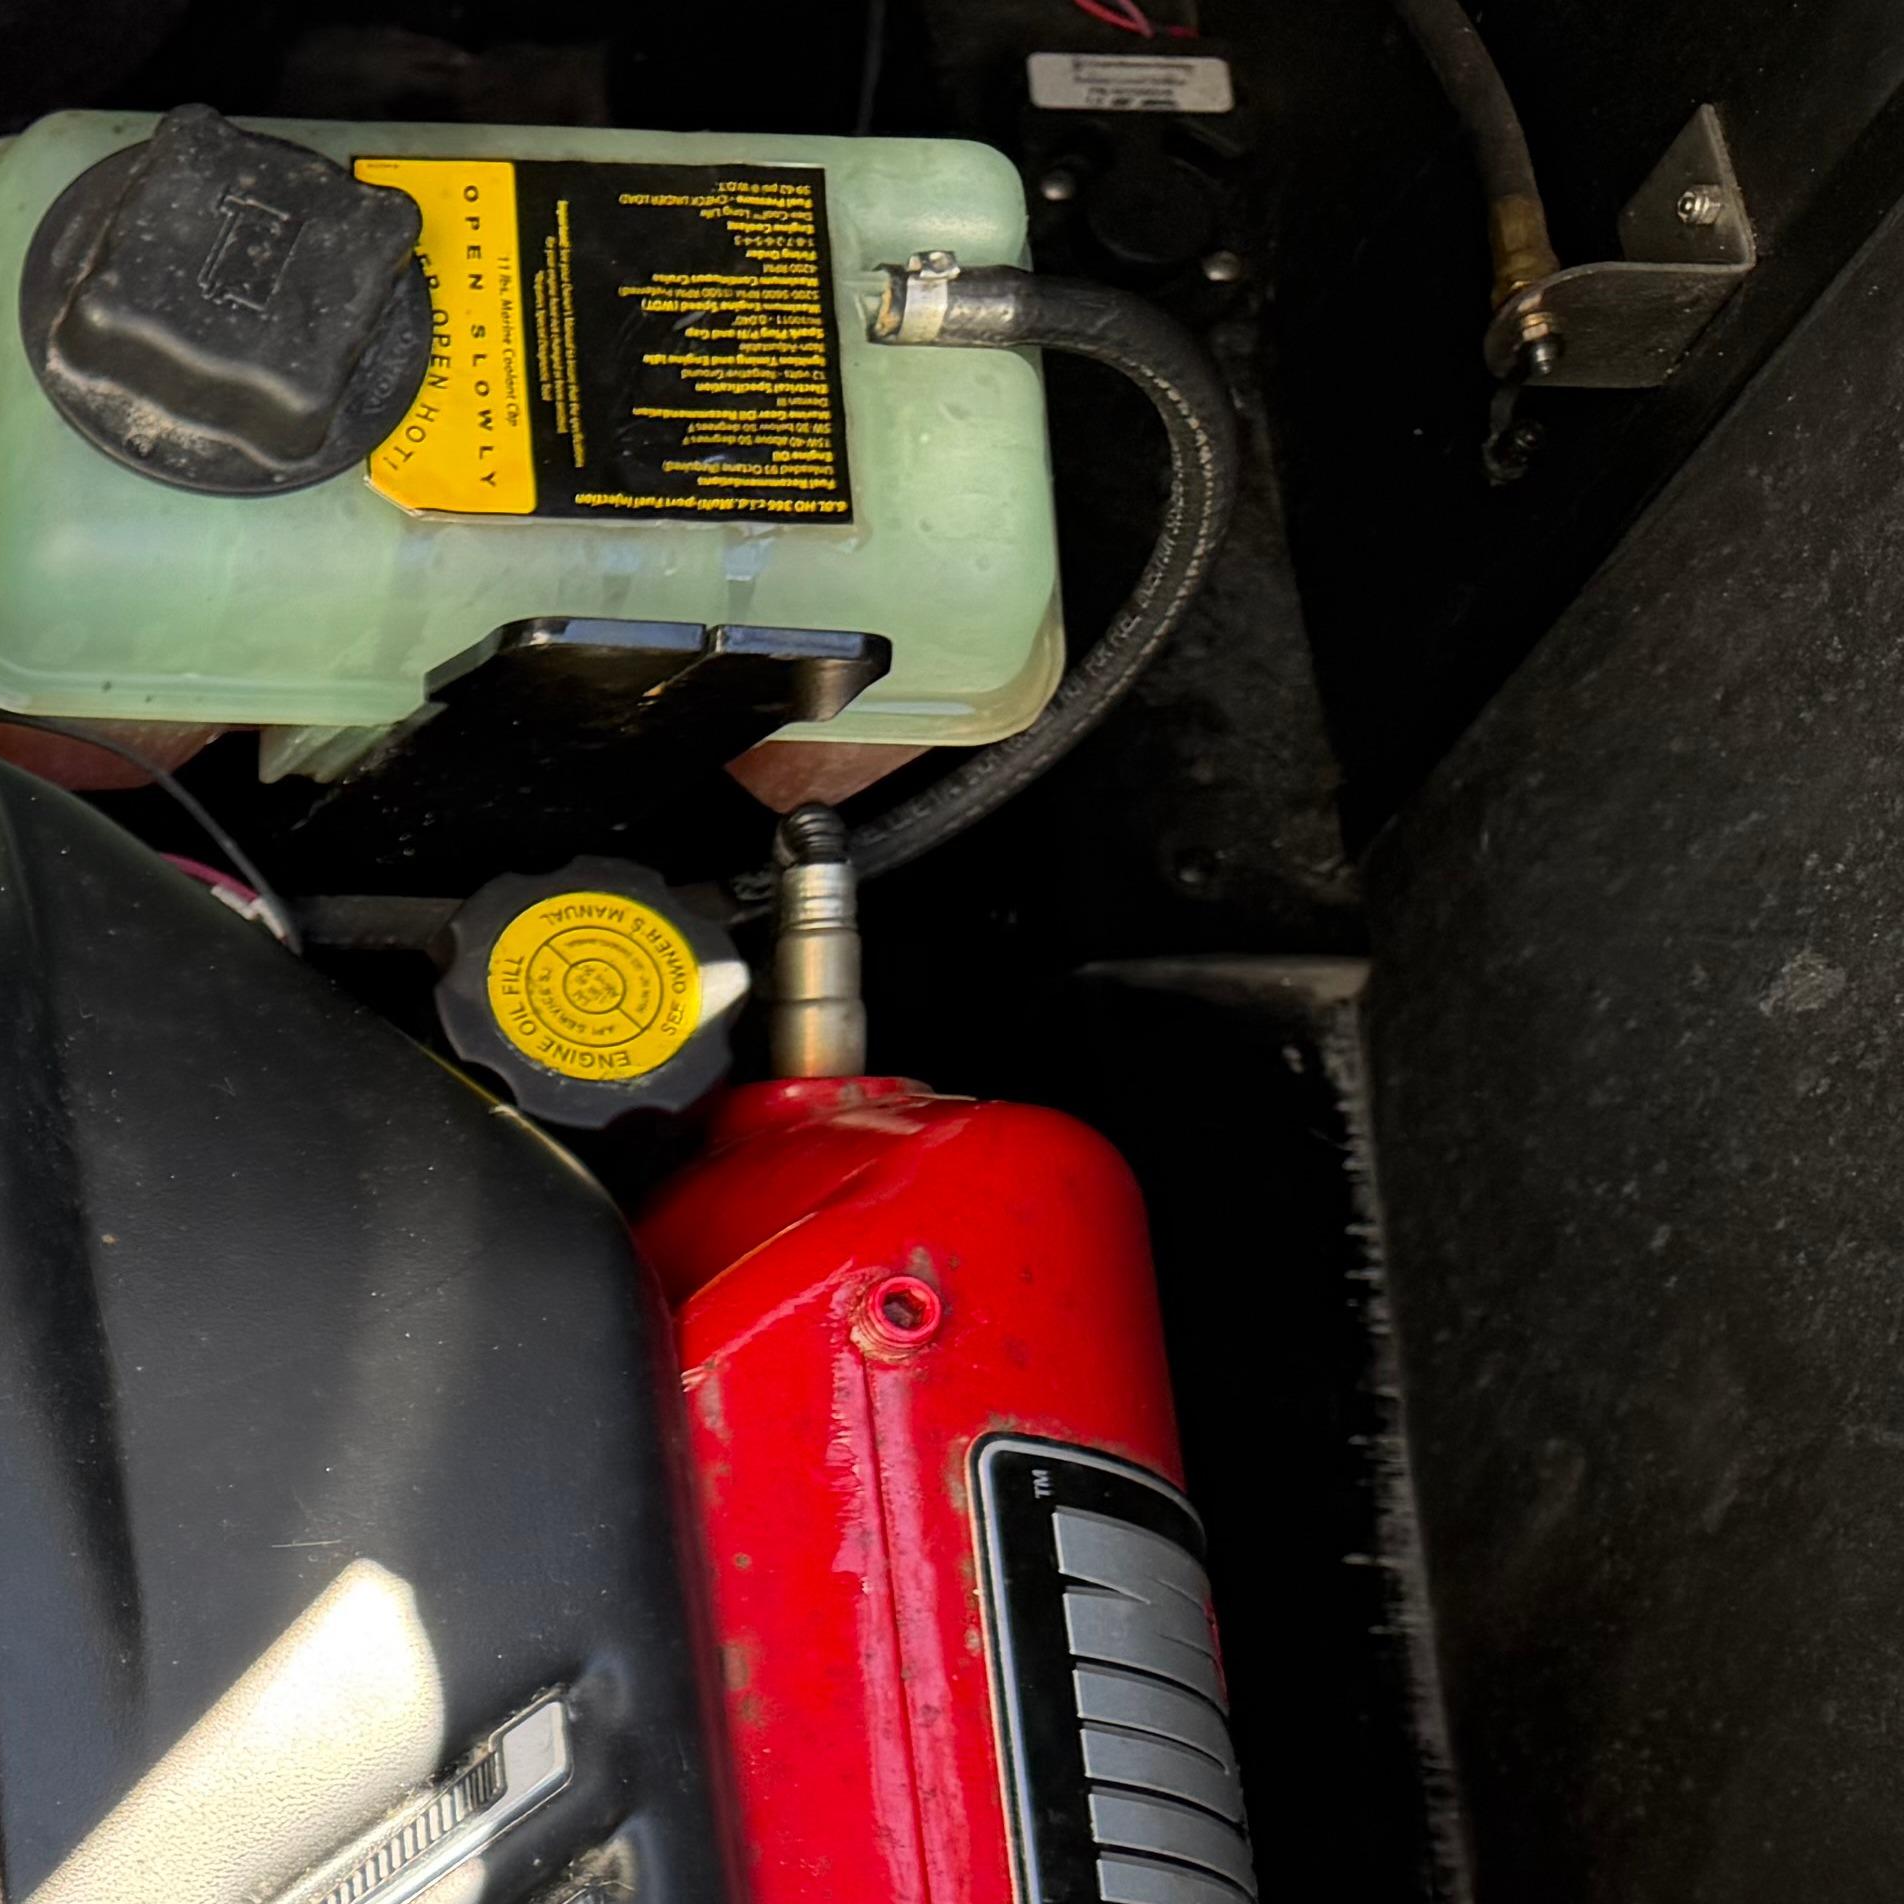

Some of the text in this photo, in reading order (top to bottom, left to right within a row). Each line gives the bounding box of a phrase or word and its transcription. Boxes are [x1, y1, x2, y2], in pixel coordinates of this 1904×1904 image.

[464, 185, 497, 488] OPEN SLOWLY
[499, 300, 516, 344] Marine
[428, 308, 451, 391] OPEN
[501, 348, 520, 400] Coolant
[382, 402, 439, 471] HOT!
[792, 451, 834, 462] Engine
[539, 902, 628, 928] MANUAL
[501, 954, 527, 998] FILL
[630, 916, 688, 994] OWNER'S
[506, 1006, 534, 1037] OIL
[660, 1001, 688, 1036] SEE
[536, 1035, 633, 1070] ENGINE
